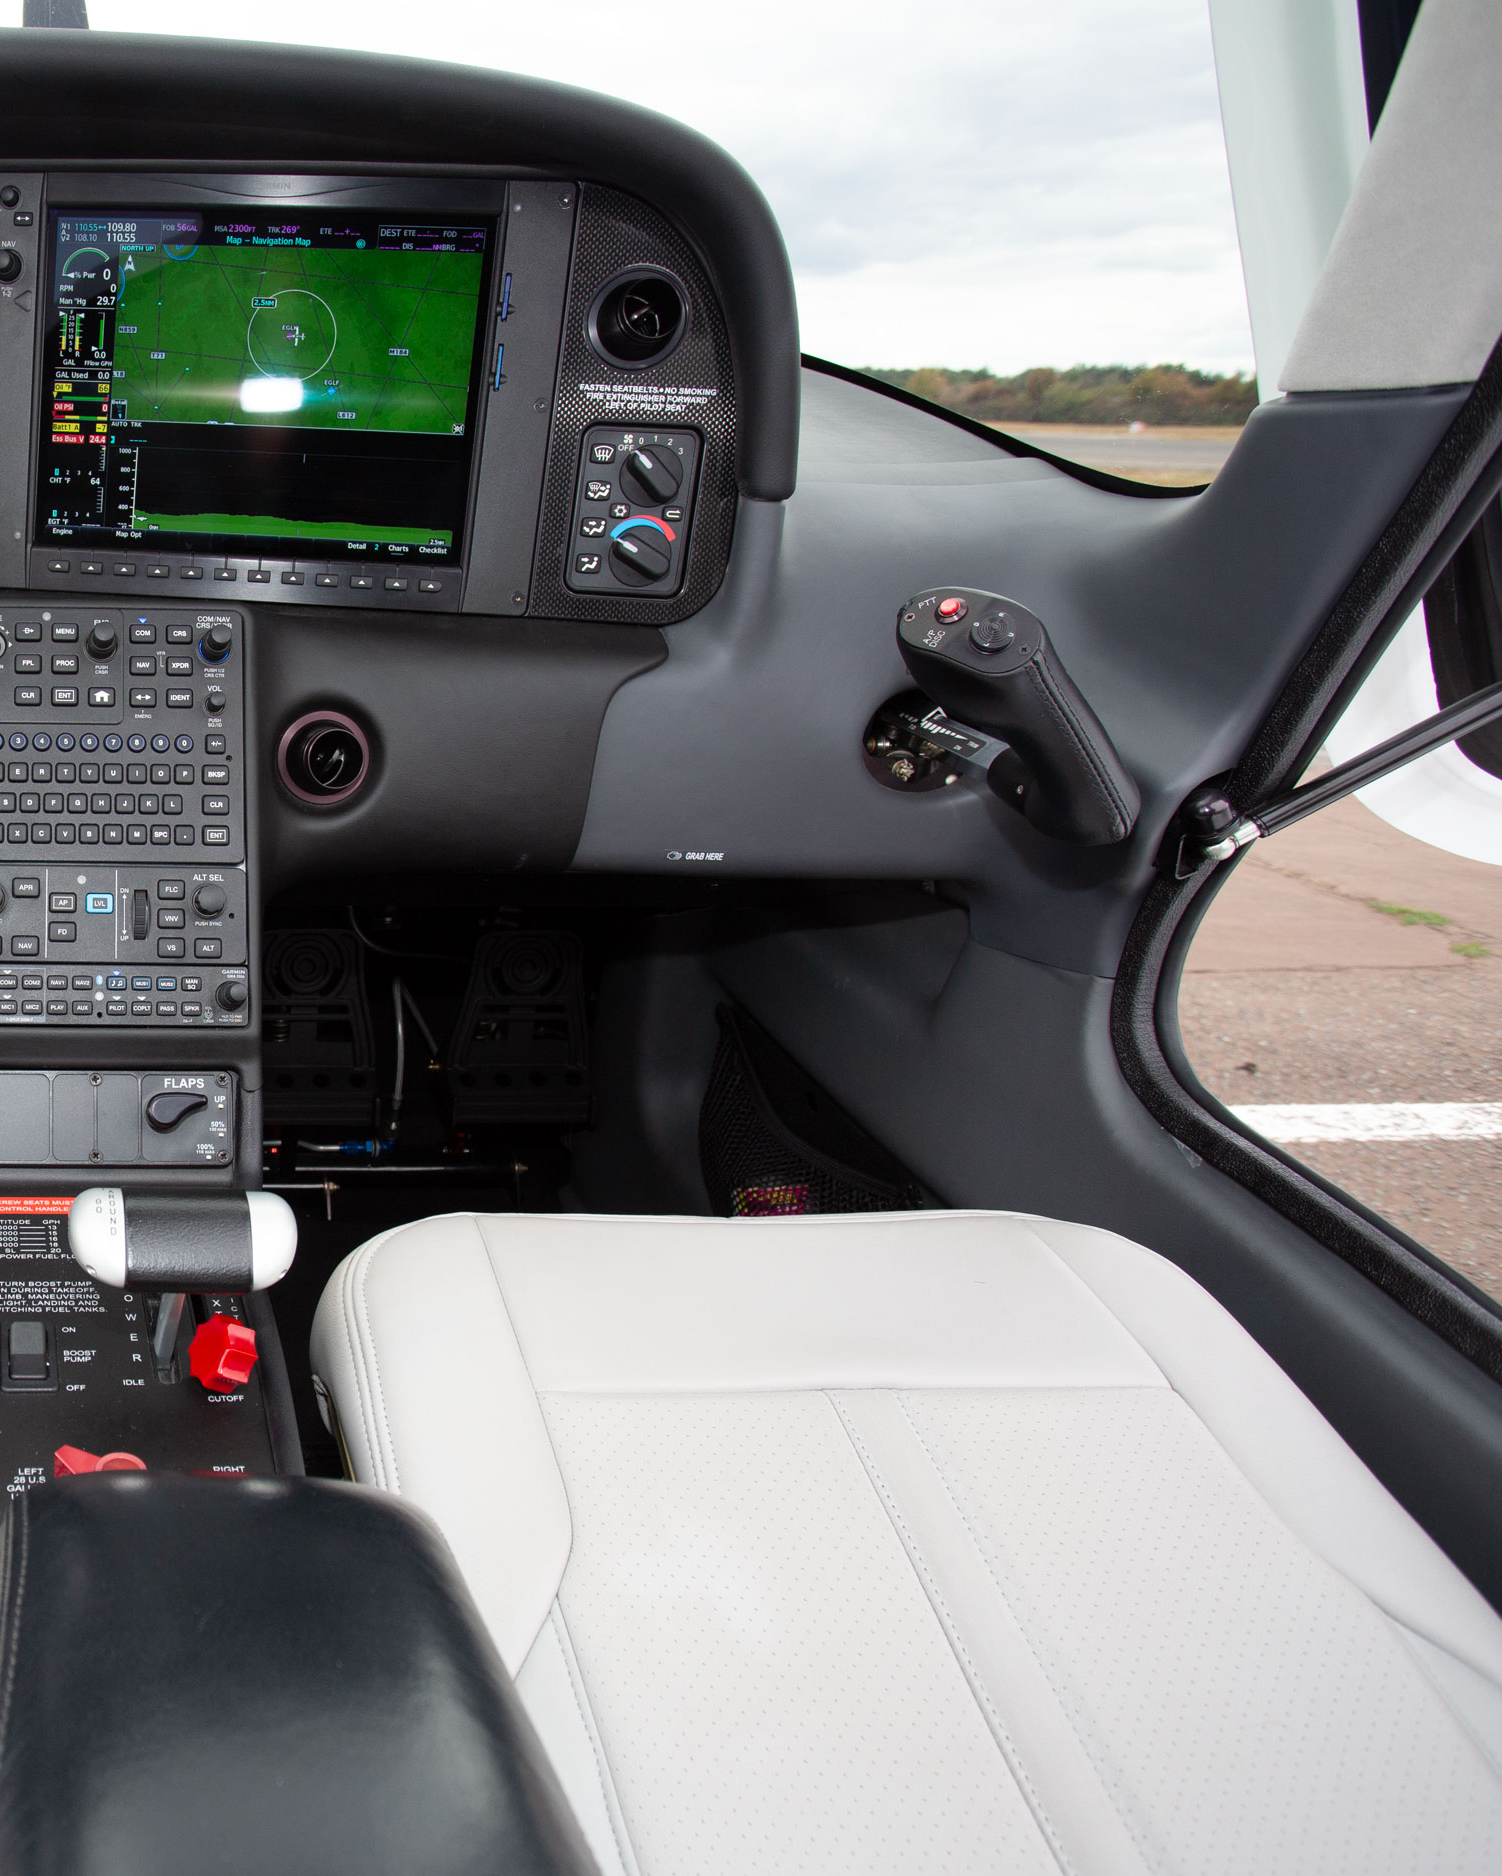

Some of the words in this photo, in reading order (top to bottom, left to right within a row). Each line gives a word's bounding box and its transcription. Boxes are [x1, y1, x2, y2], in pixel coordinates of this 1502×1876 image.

[107, 223, 136, 231] 109.80
[282, 226, 300, 234] 269°
[107, 233, 136, 242] 110.55
[226, 236, 241, 244] Map
[252, 237, 293, 246] Navigation
[296, 238, 311, 246] Map
[97, 296, 115, 305] 29.7
[679, 388, 716, 396] SMOKING
[606, 394, 664, 402] EXTINGUISHER
[53, 528, 73, 536] Engine
[419, 546, 447, 554] Checklist
[918, 596, 936, 609] PTT
[686, 852, 705, 860] GRAB
[164, 1078, 204, 1088] FLAPS
